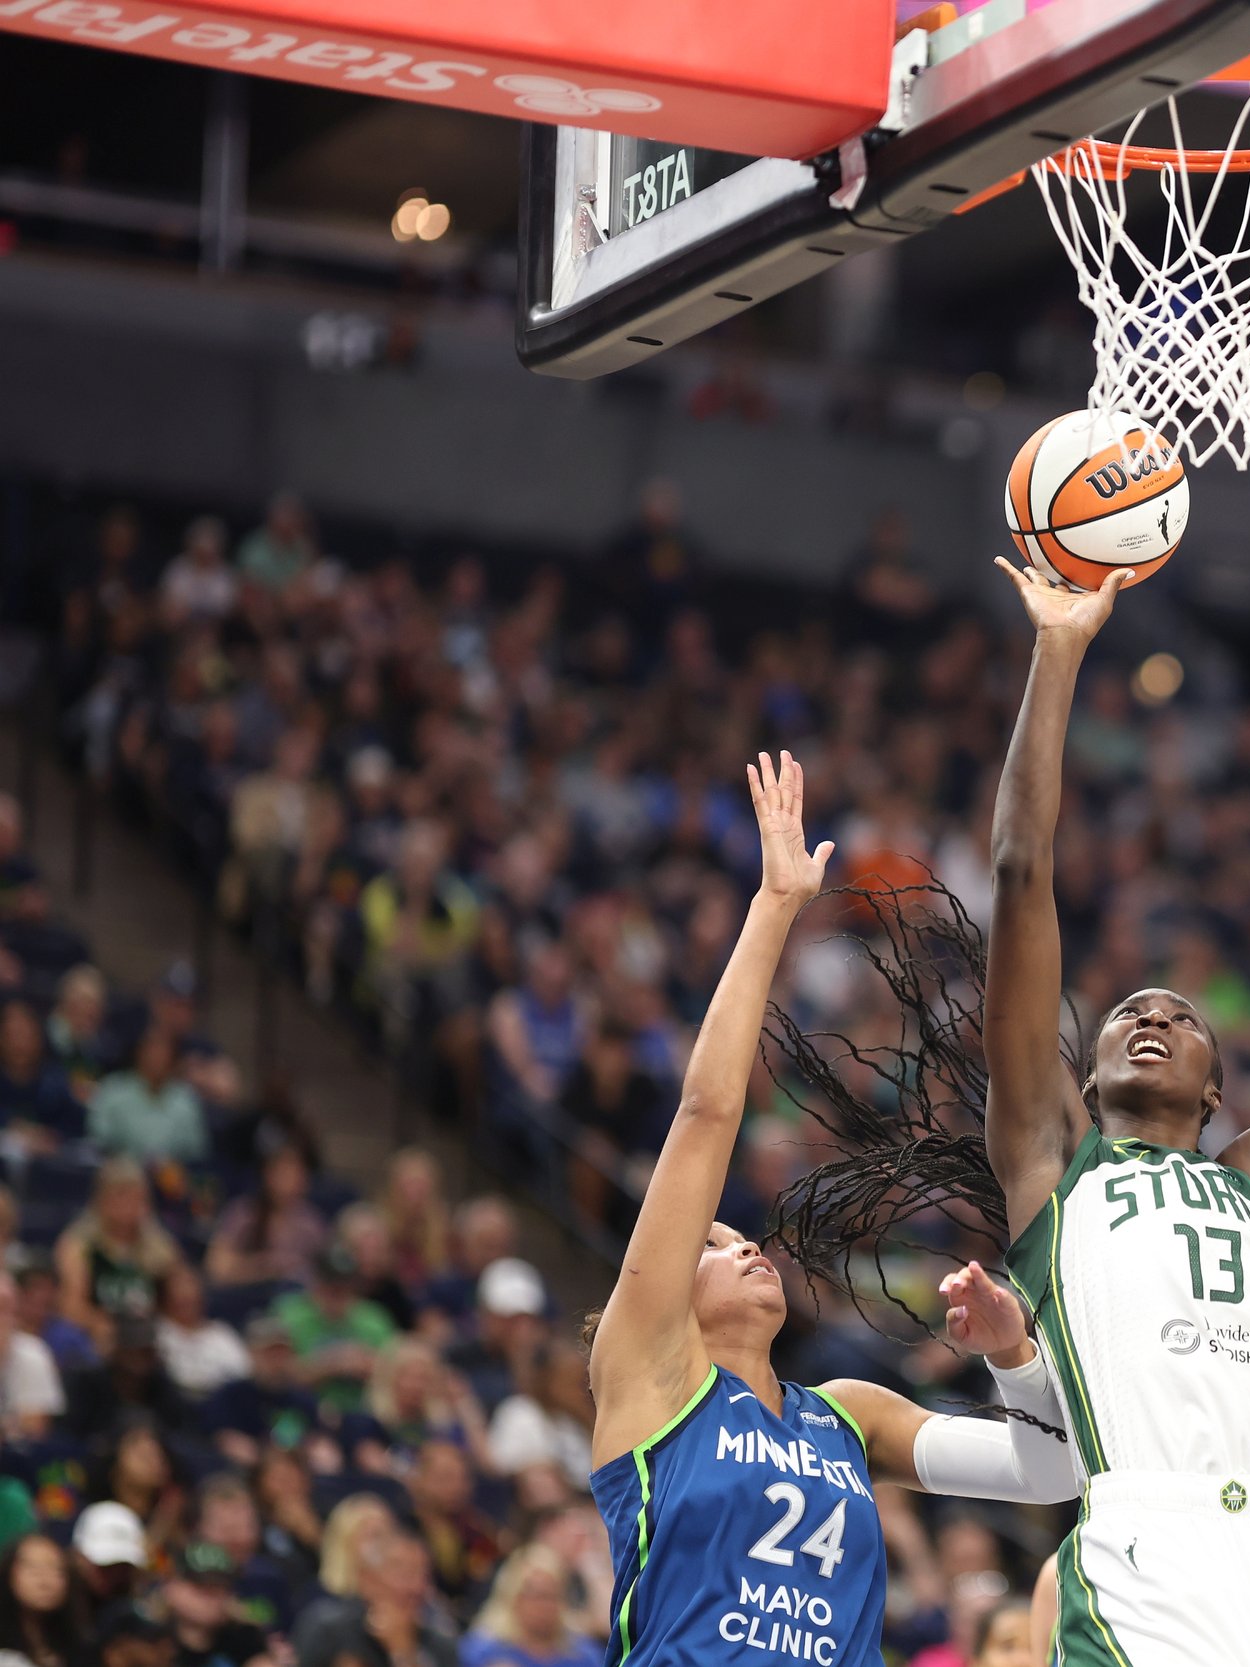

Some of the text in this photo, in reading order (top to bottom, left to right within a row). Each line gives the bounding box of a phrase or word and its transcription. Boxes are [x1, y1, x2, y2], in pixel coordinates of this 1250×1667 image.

[171, 23, 486, 91] State
[1121, 533, 1150, 543] OFFICIAL
[1173, 1223, 1244, 1305] 13
[716, 1426, 874, 1504] MINNEOTA
[748, 1481, 848, 1579] 24
[739, 1576, 833, 1626] MAYO
[719, 1612, 837, 1667] CLINIC
